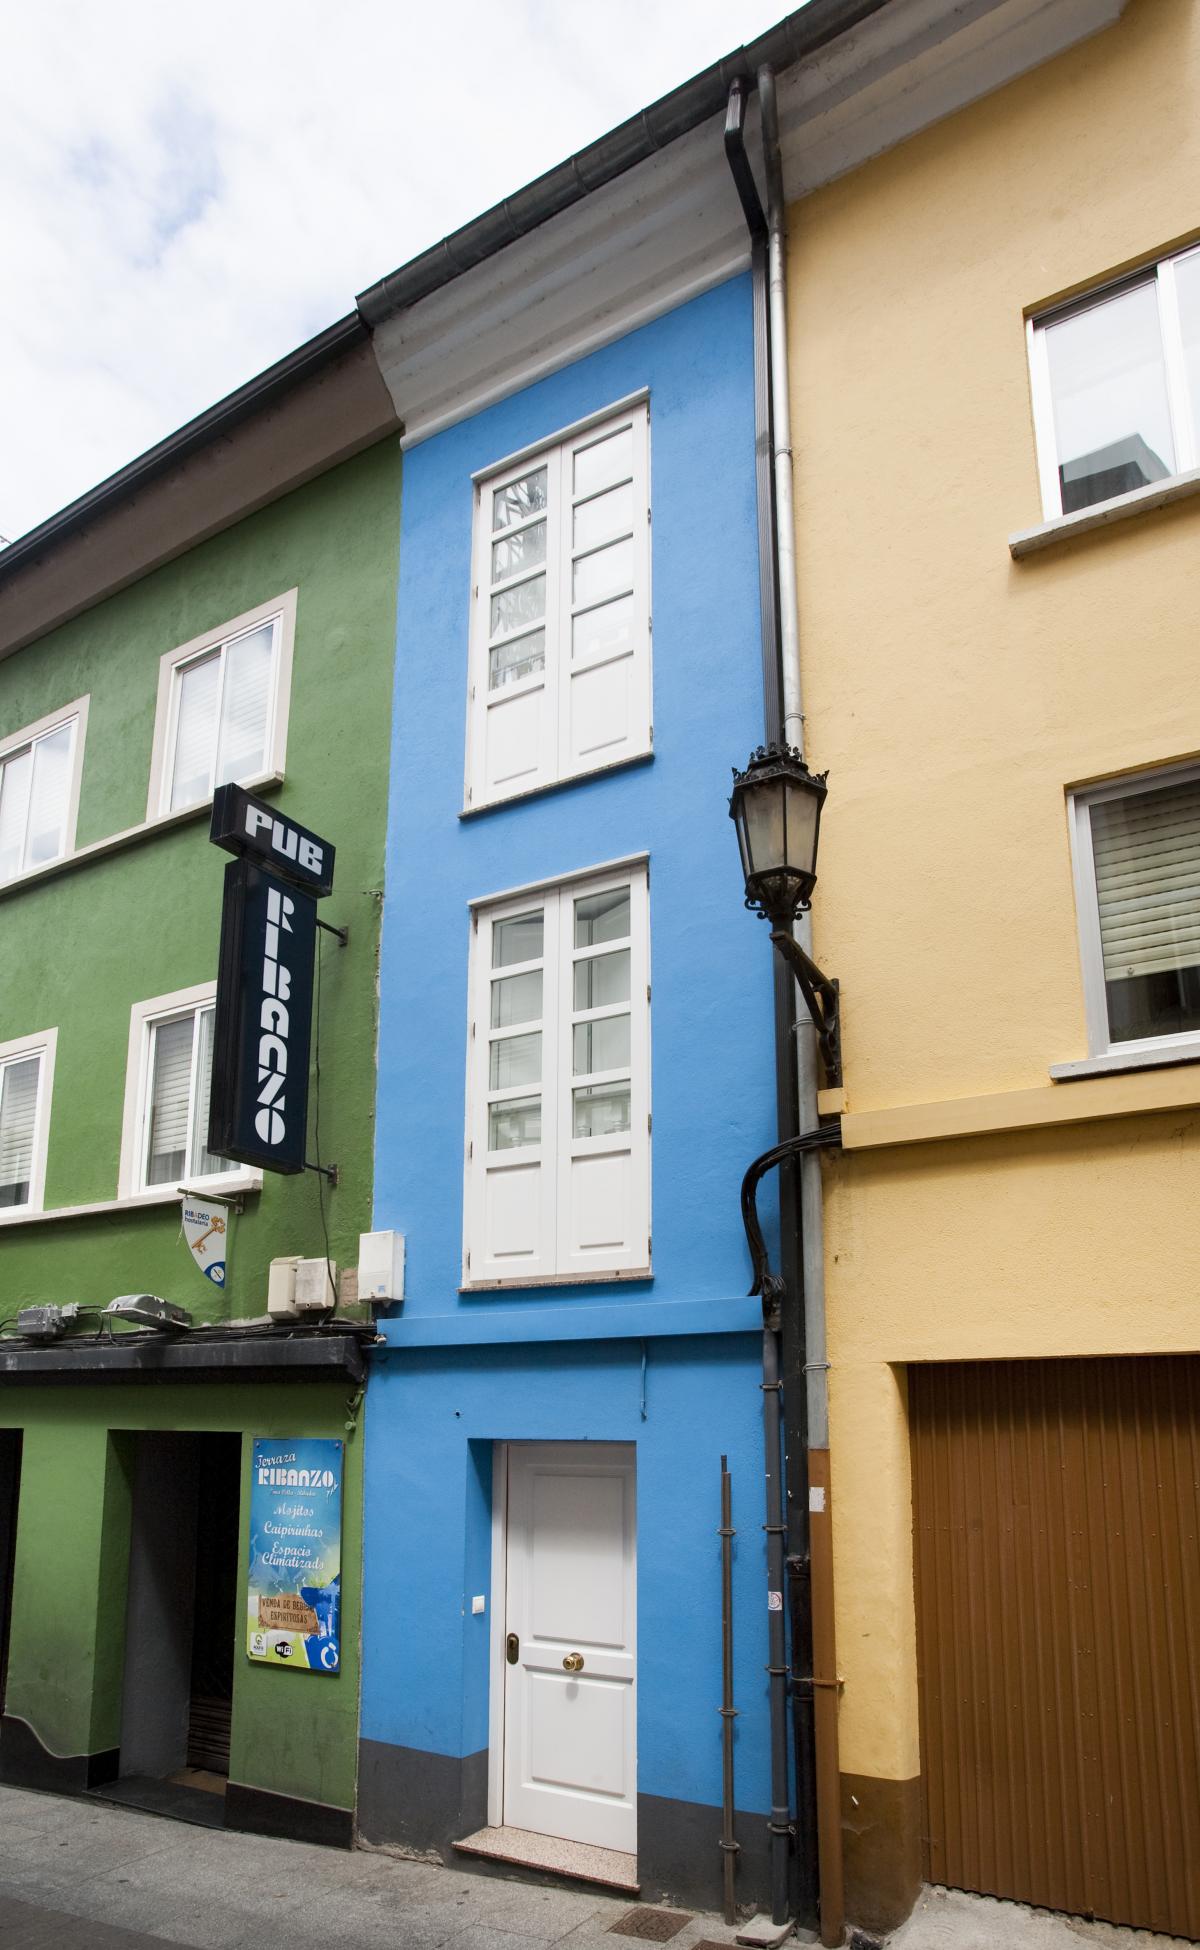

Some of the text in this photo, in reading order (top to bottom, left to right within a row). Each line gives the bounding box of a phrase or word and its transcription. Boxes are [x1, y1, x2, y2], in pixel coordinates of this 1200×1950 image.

[245, 804, 323, 876] PUB
[254, 887, 295, 1145] RIBANZO
[184, 1209, 210, 1220] RIBADEO
[256, 1453, 296, 1468] Terraza
[258, 1468, 334, 1488] RIBANZO
[273, 1502, 314, 1519] Mojitos
[264, 1521, 323, 1539] Caipirinhas
[272, 1541, 311, 1557] Espacio
[261, 1552, 324, 1570] Climatizado
